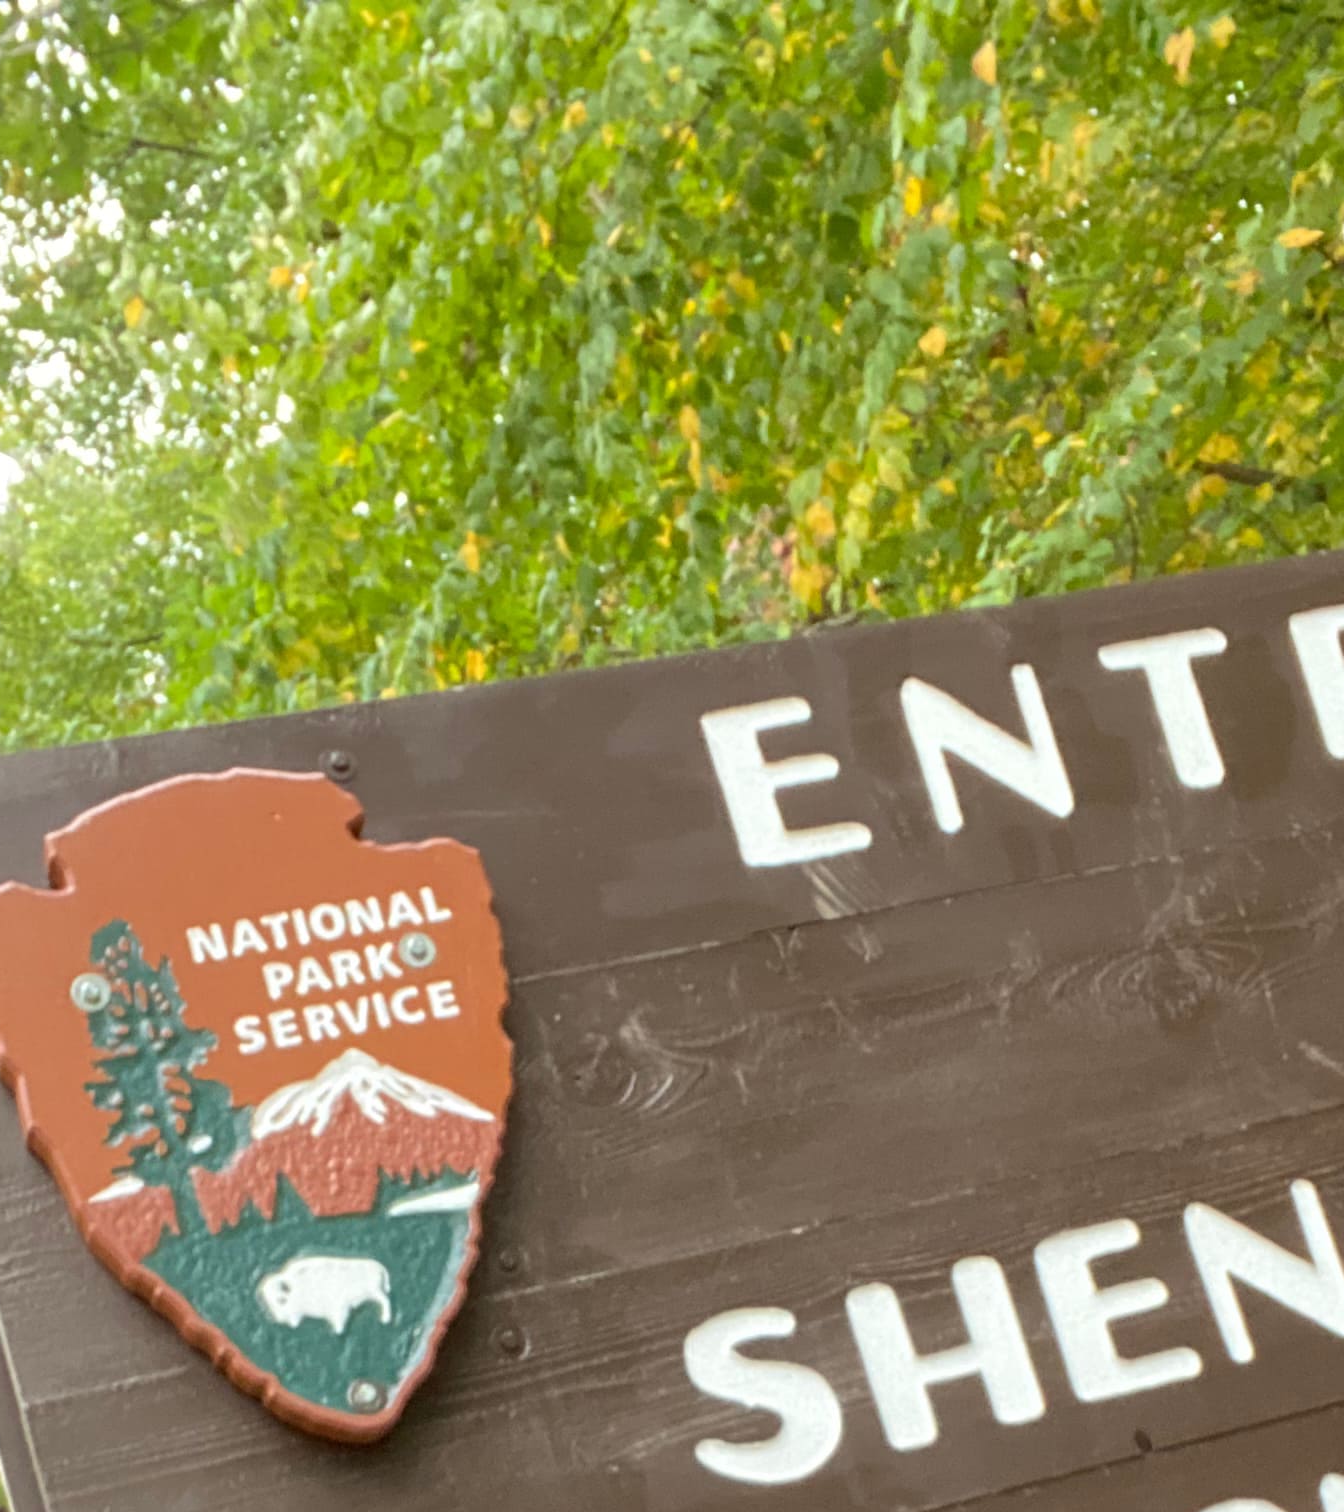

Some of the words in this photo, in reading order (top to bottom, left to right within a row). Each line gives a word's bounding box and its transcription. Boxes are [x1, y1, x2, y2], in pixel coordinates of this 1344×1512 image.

[186, 886, 452, 964] NATIONAL
[262, 942, 403, 1001] PARK
[233, 980, 460, 1055] SERVICE
